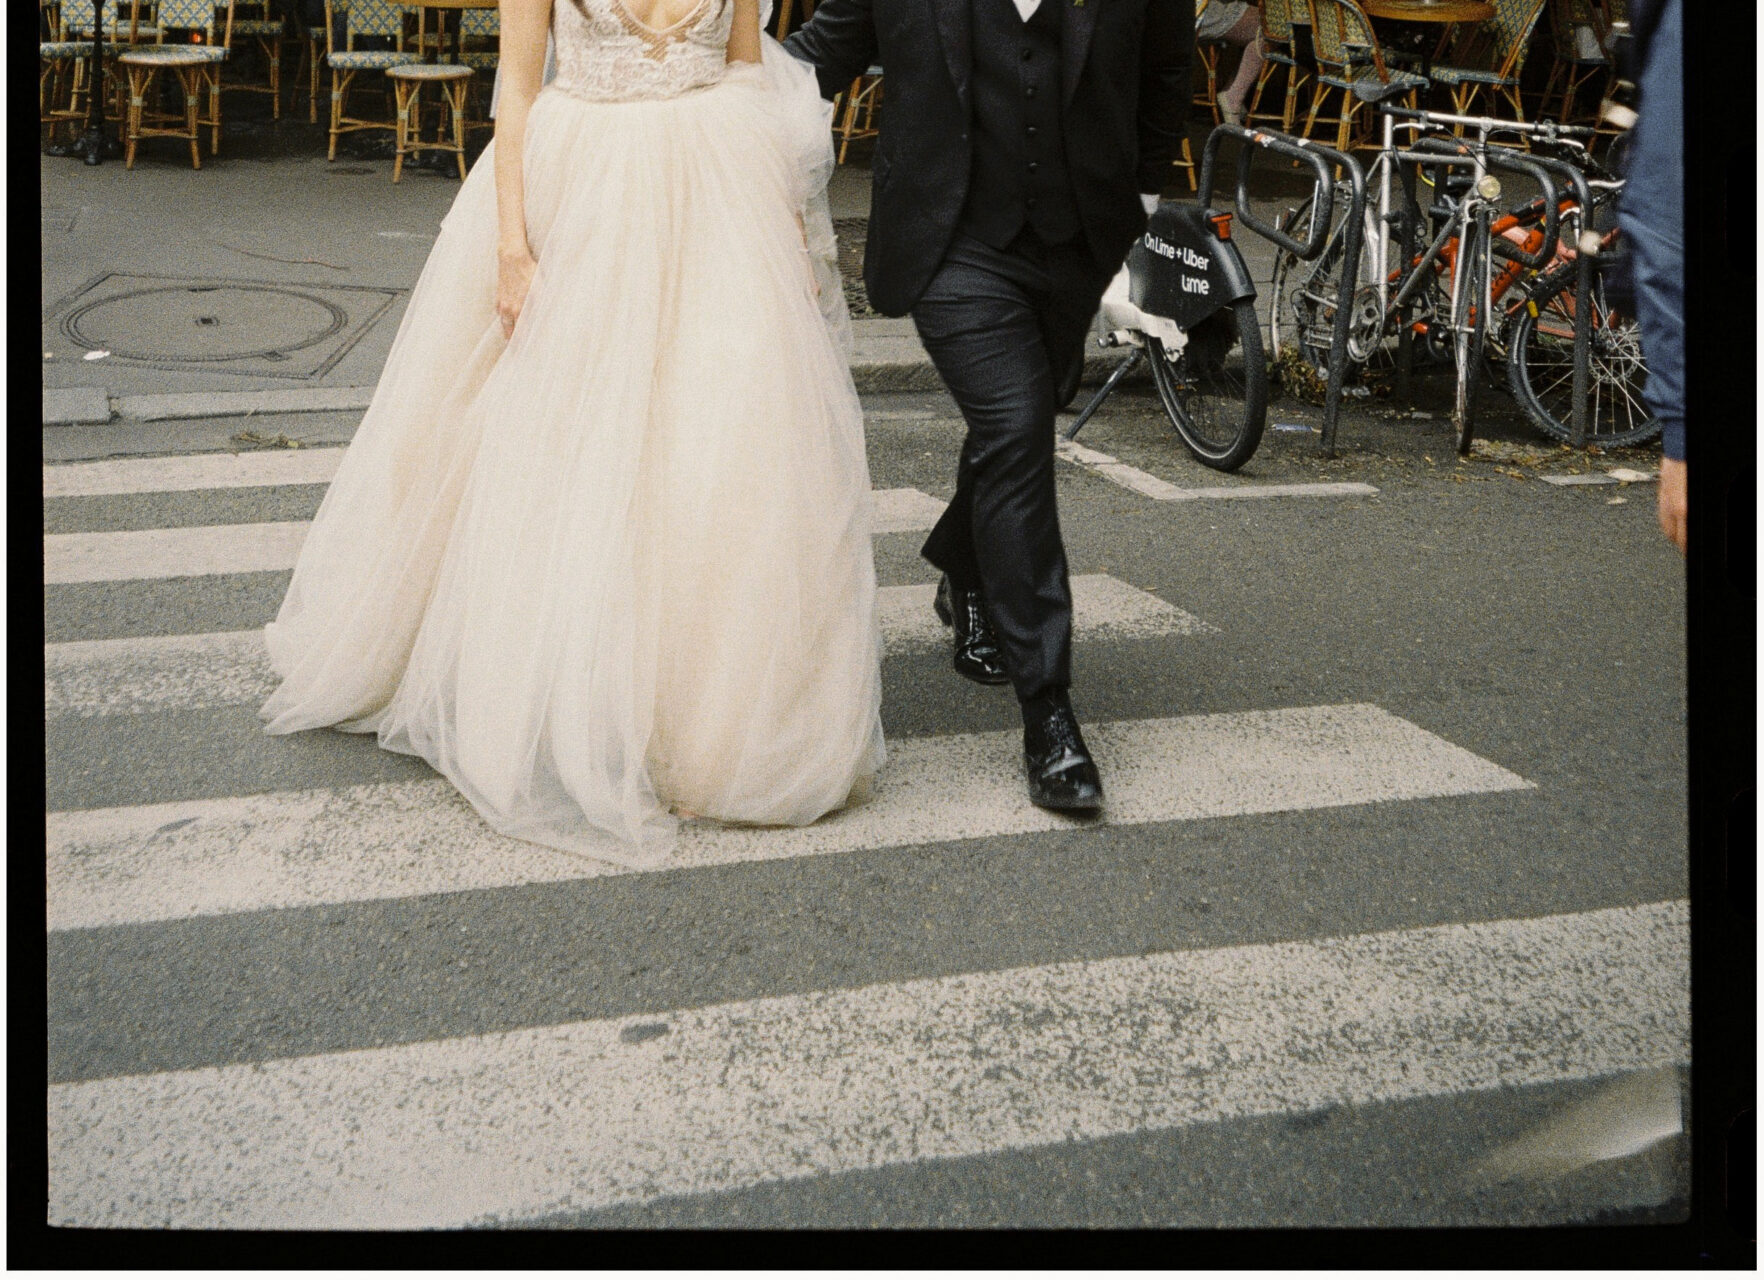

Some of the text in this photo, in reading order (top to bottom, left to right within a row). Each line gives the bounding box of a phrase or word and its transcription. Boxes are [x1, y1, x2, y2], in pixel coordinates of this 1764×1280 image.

[1145, 232, 1155, 251] On
[1155, 236, 1175, 259] Lime
[1183, 247, 1209, 271] Uber
